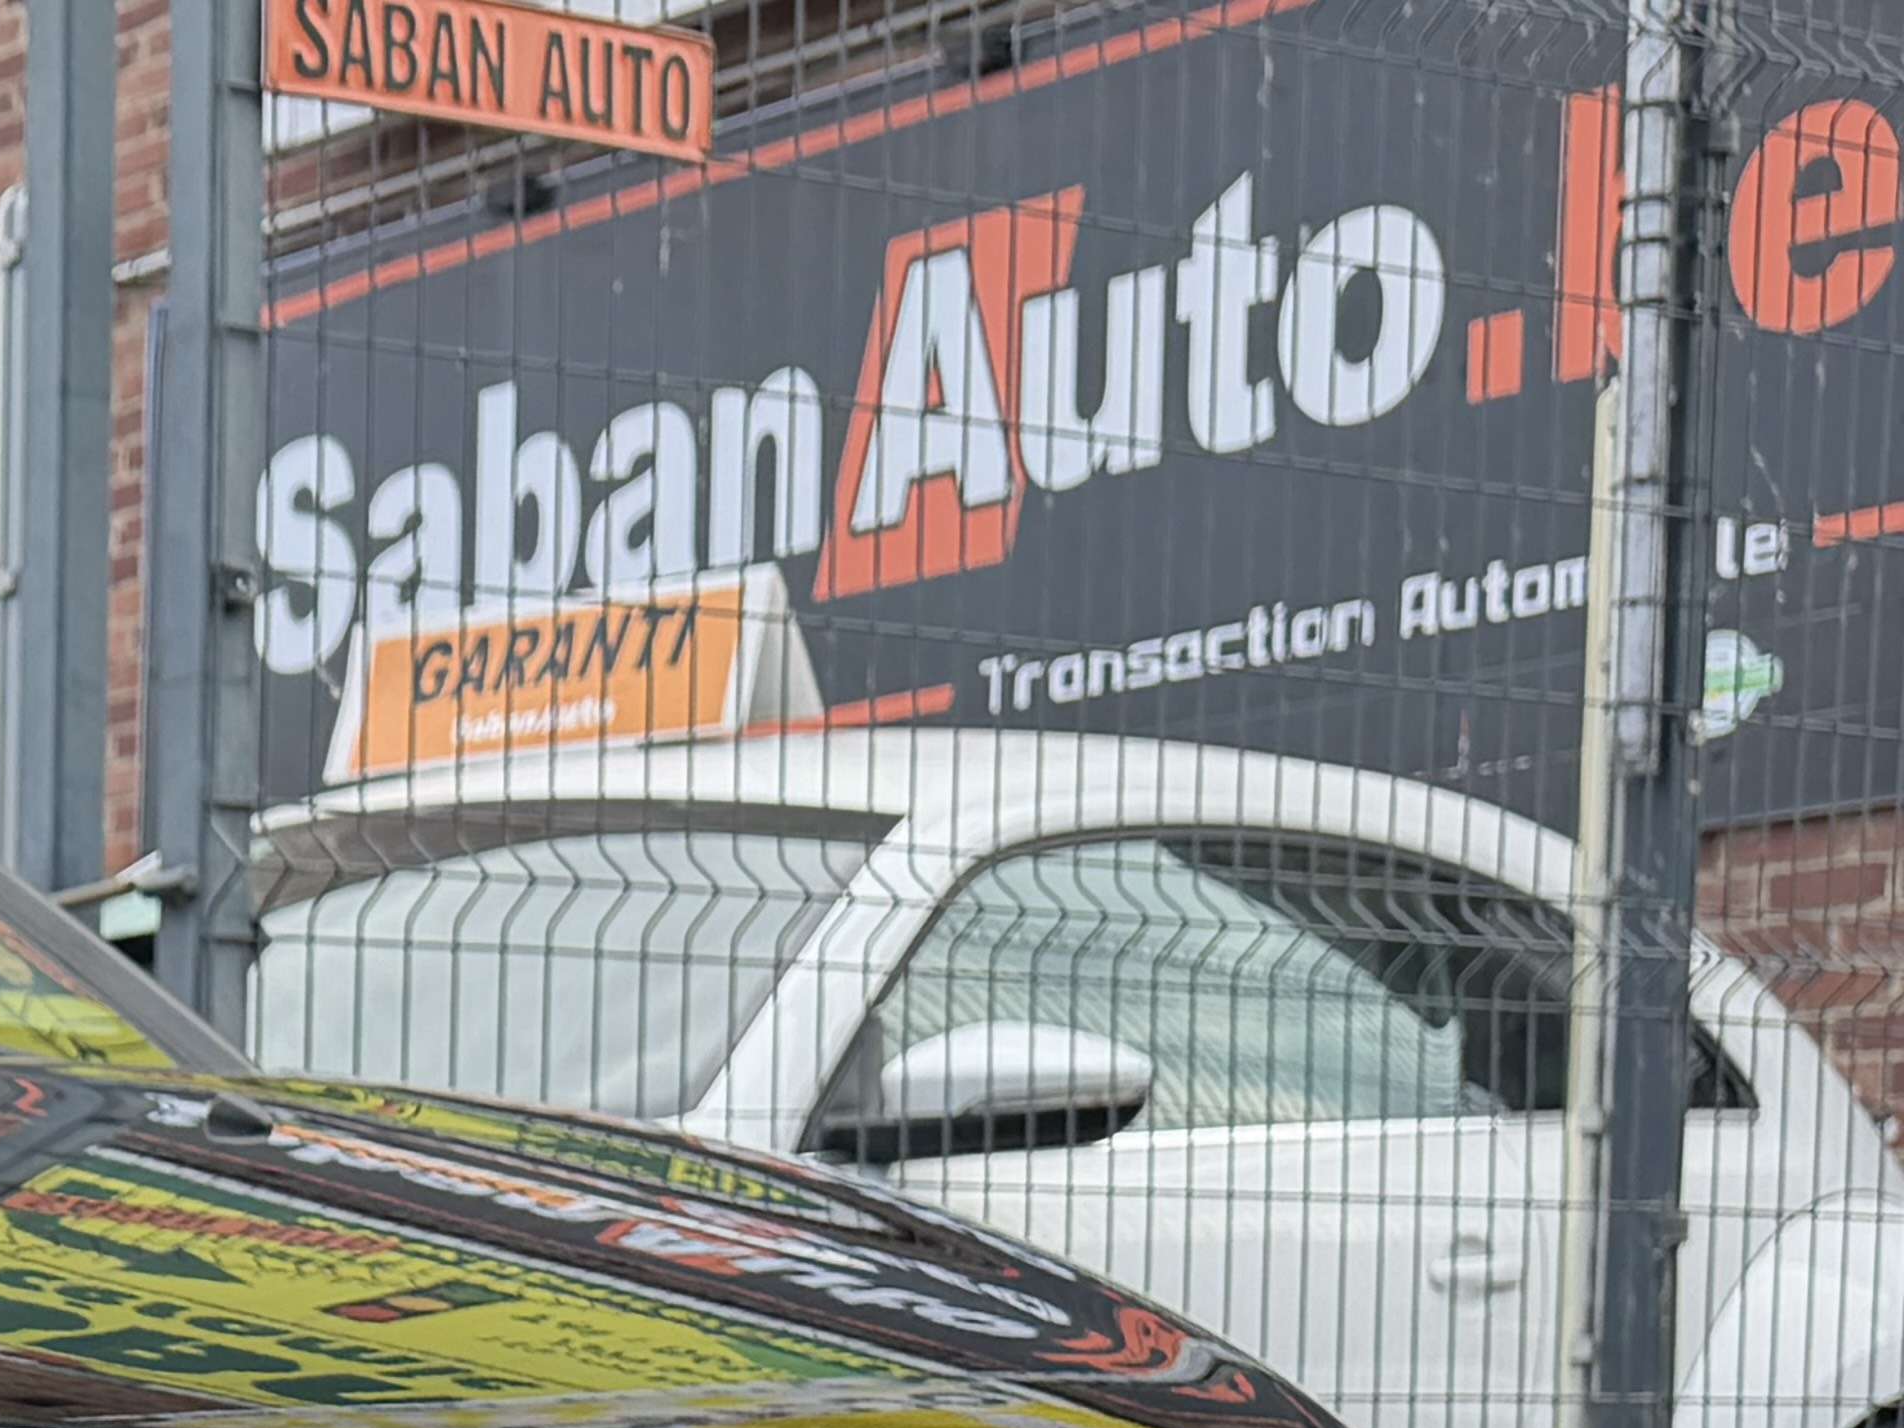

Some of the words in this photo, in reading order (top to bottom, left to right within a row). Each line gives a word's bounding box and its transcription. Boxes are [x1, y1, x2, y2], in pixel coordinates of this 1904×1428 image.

[294, 0, 504, 112] SABAN
[540, 32, 690, 140] AUTO
[414, 603, 699, 705] GARANTI
[979, 600, 1376, 716] Transaction
[1400, 515, 1780, 640] Automle
